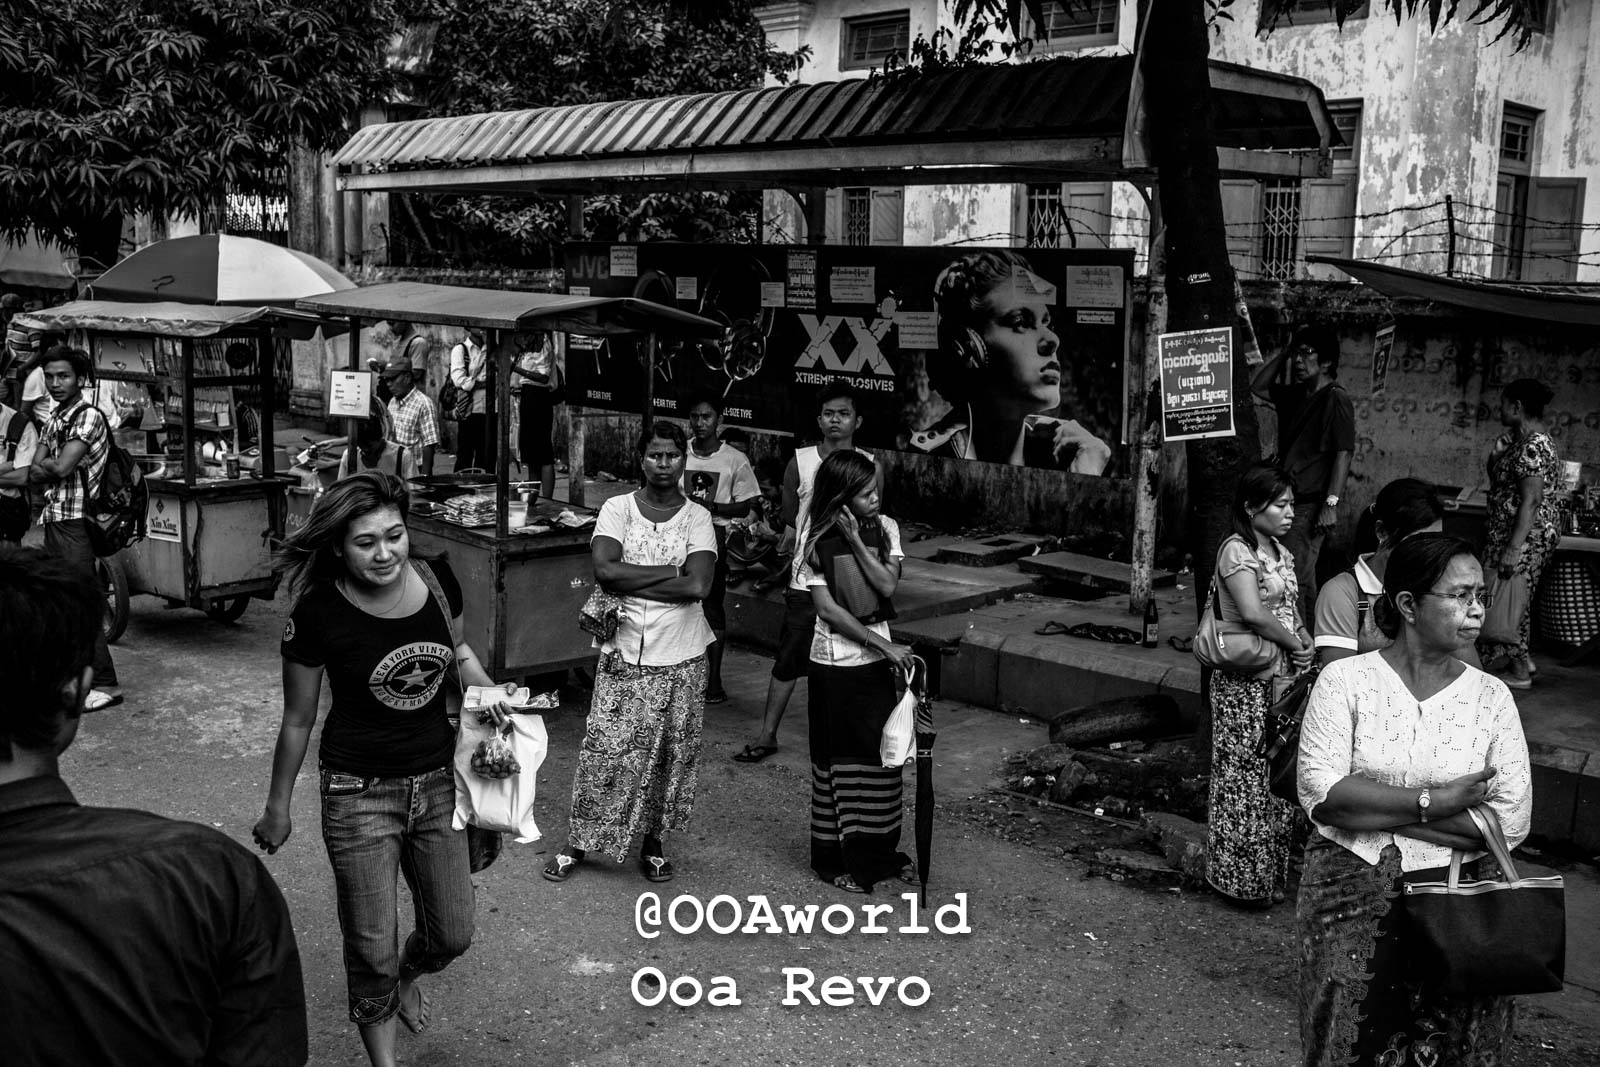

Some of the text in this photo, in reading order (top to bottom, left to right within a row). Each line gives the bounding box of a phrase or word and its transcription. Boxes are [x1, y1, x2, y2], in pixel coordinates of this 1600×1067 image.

[572, 255, 608, 279] JVC
[794, 313, 895, 375] XX
[795, 371, 834, 385] XTREME
[602, 392, 612, 401] TYPE
[666, 399, 677, 410] TYPE
[740, 408, 752, 419] TYPE
[372, 662, 391, 683] NEW
[389, 646, 416, 664] YORK
